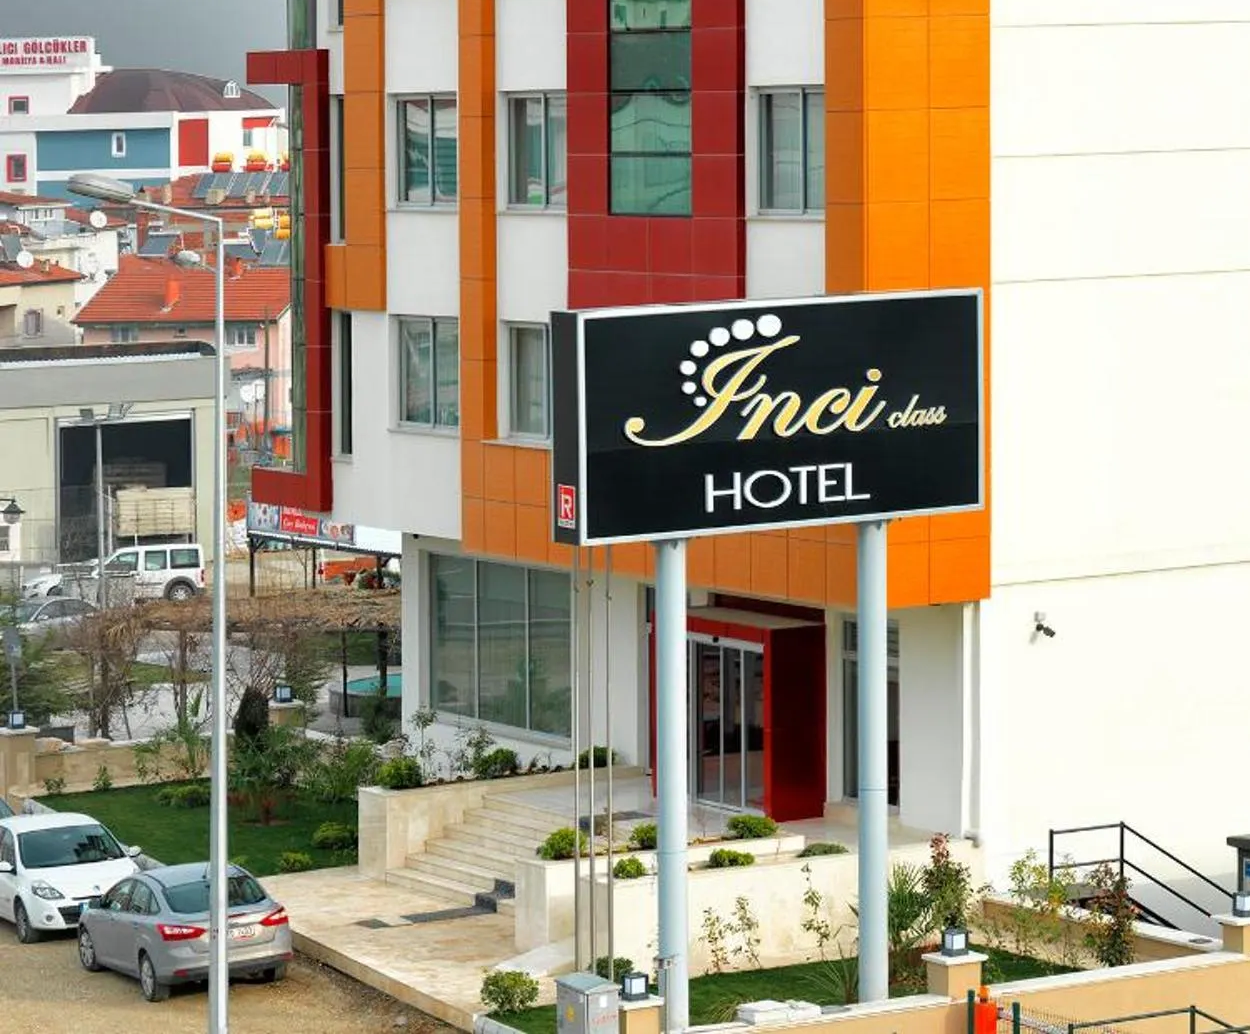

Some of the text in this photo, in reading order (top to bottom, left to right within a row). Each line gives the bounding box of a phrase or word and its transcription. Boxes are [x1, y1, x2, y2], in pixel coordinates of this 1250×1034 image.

[887, 394, 948, 429] class
[704, 463, 872, 513] HOTEL
[561, 493, 573, 519] R
